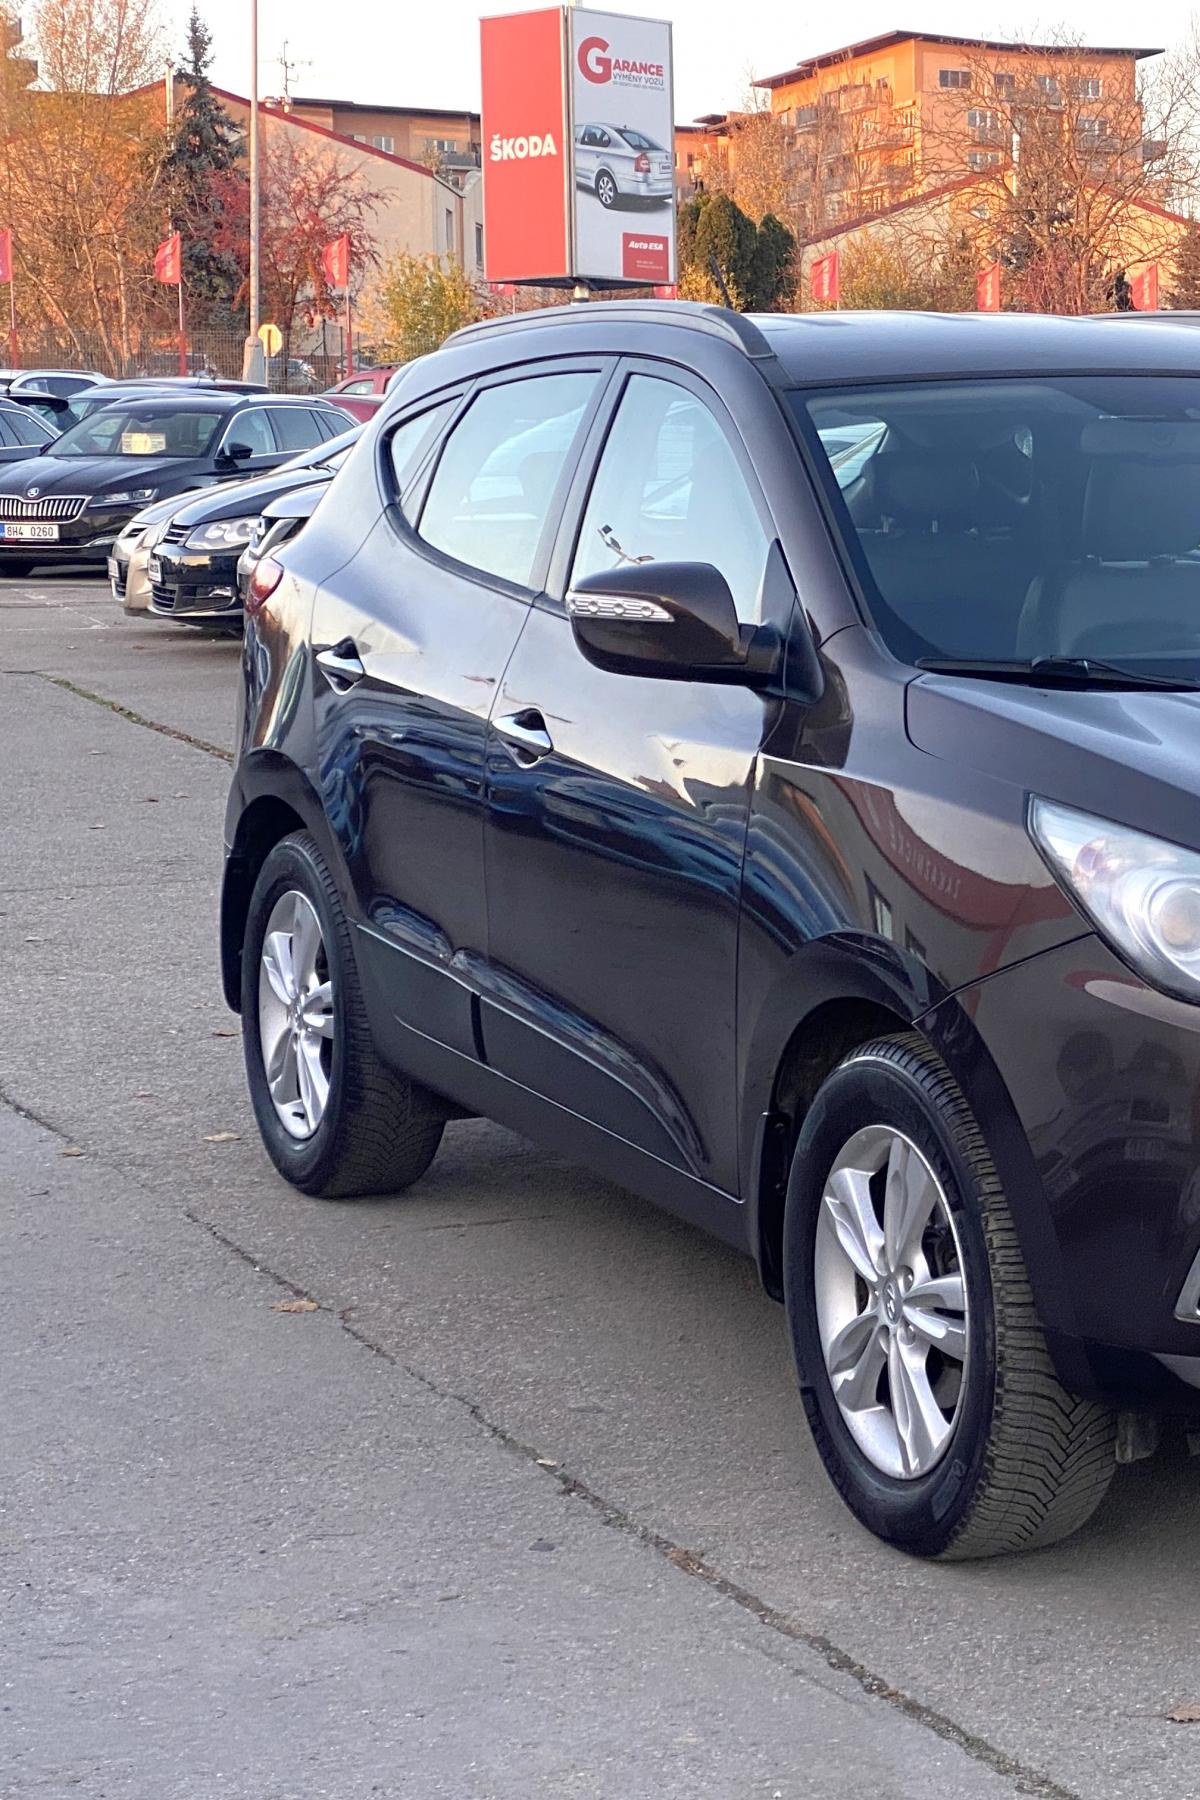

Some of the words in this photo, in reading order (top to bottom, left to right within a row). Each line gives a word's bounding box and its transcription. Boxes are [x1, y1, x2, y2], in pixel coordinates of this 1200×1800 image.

[577, 36, 664, 84] GARANCE
[643, 76, 664, 86] VOZU
[490, 133, 557, 161] ŠKODA
[7, 526, 23, 536] 8H4
[30, 526, 53, 536] 0260
